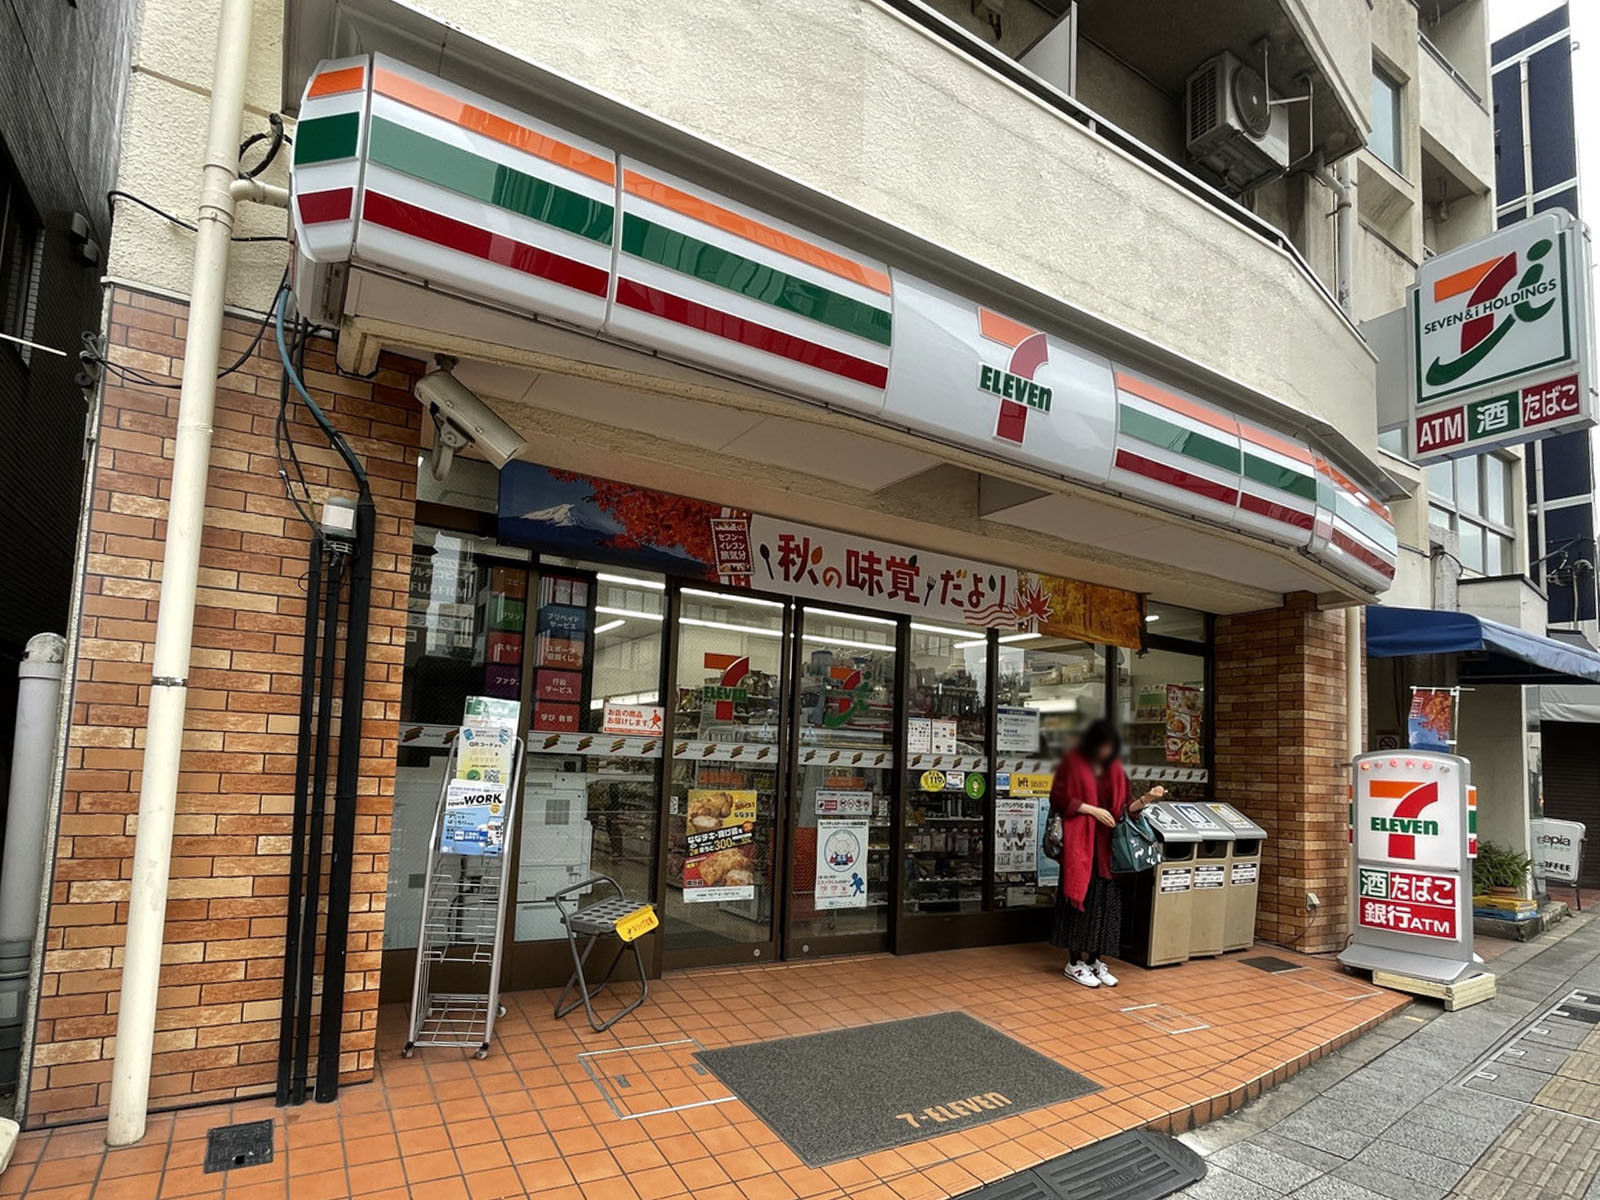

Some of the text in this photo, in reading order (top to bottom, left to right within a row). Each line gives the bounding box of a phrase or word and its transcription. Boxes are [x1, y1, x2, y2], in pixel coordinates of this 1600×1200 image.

[1483, 279, 1557, 313] HOLDINGS
[1477, 399, 1510, 434] 酒
[1524, 384, 1578, 422] たばこ
[1419, 413, 1463, 448] ATM
[464, 794, 504, 806] WORK
[1362, 870, 1387, 897] 酒
[1391, 875, 1453, 904] たばこ
